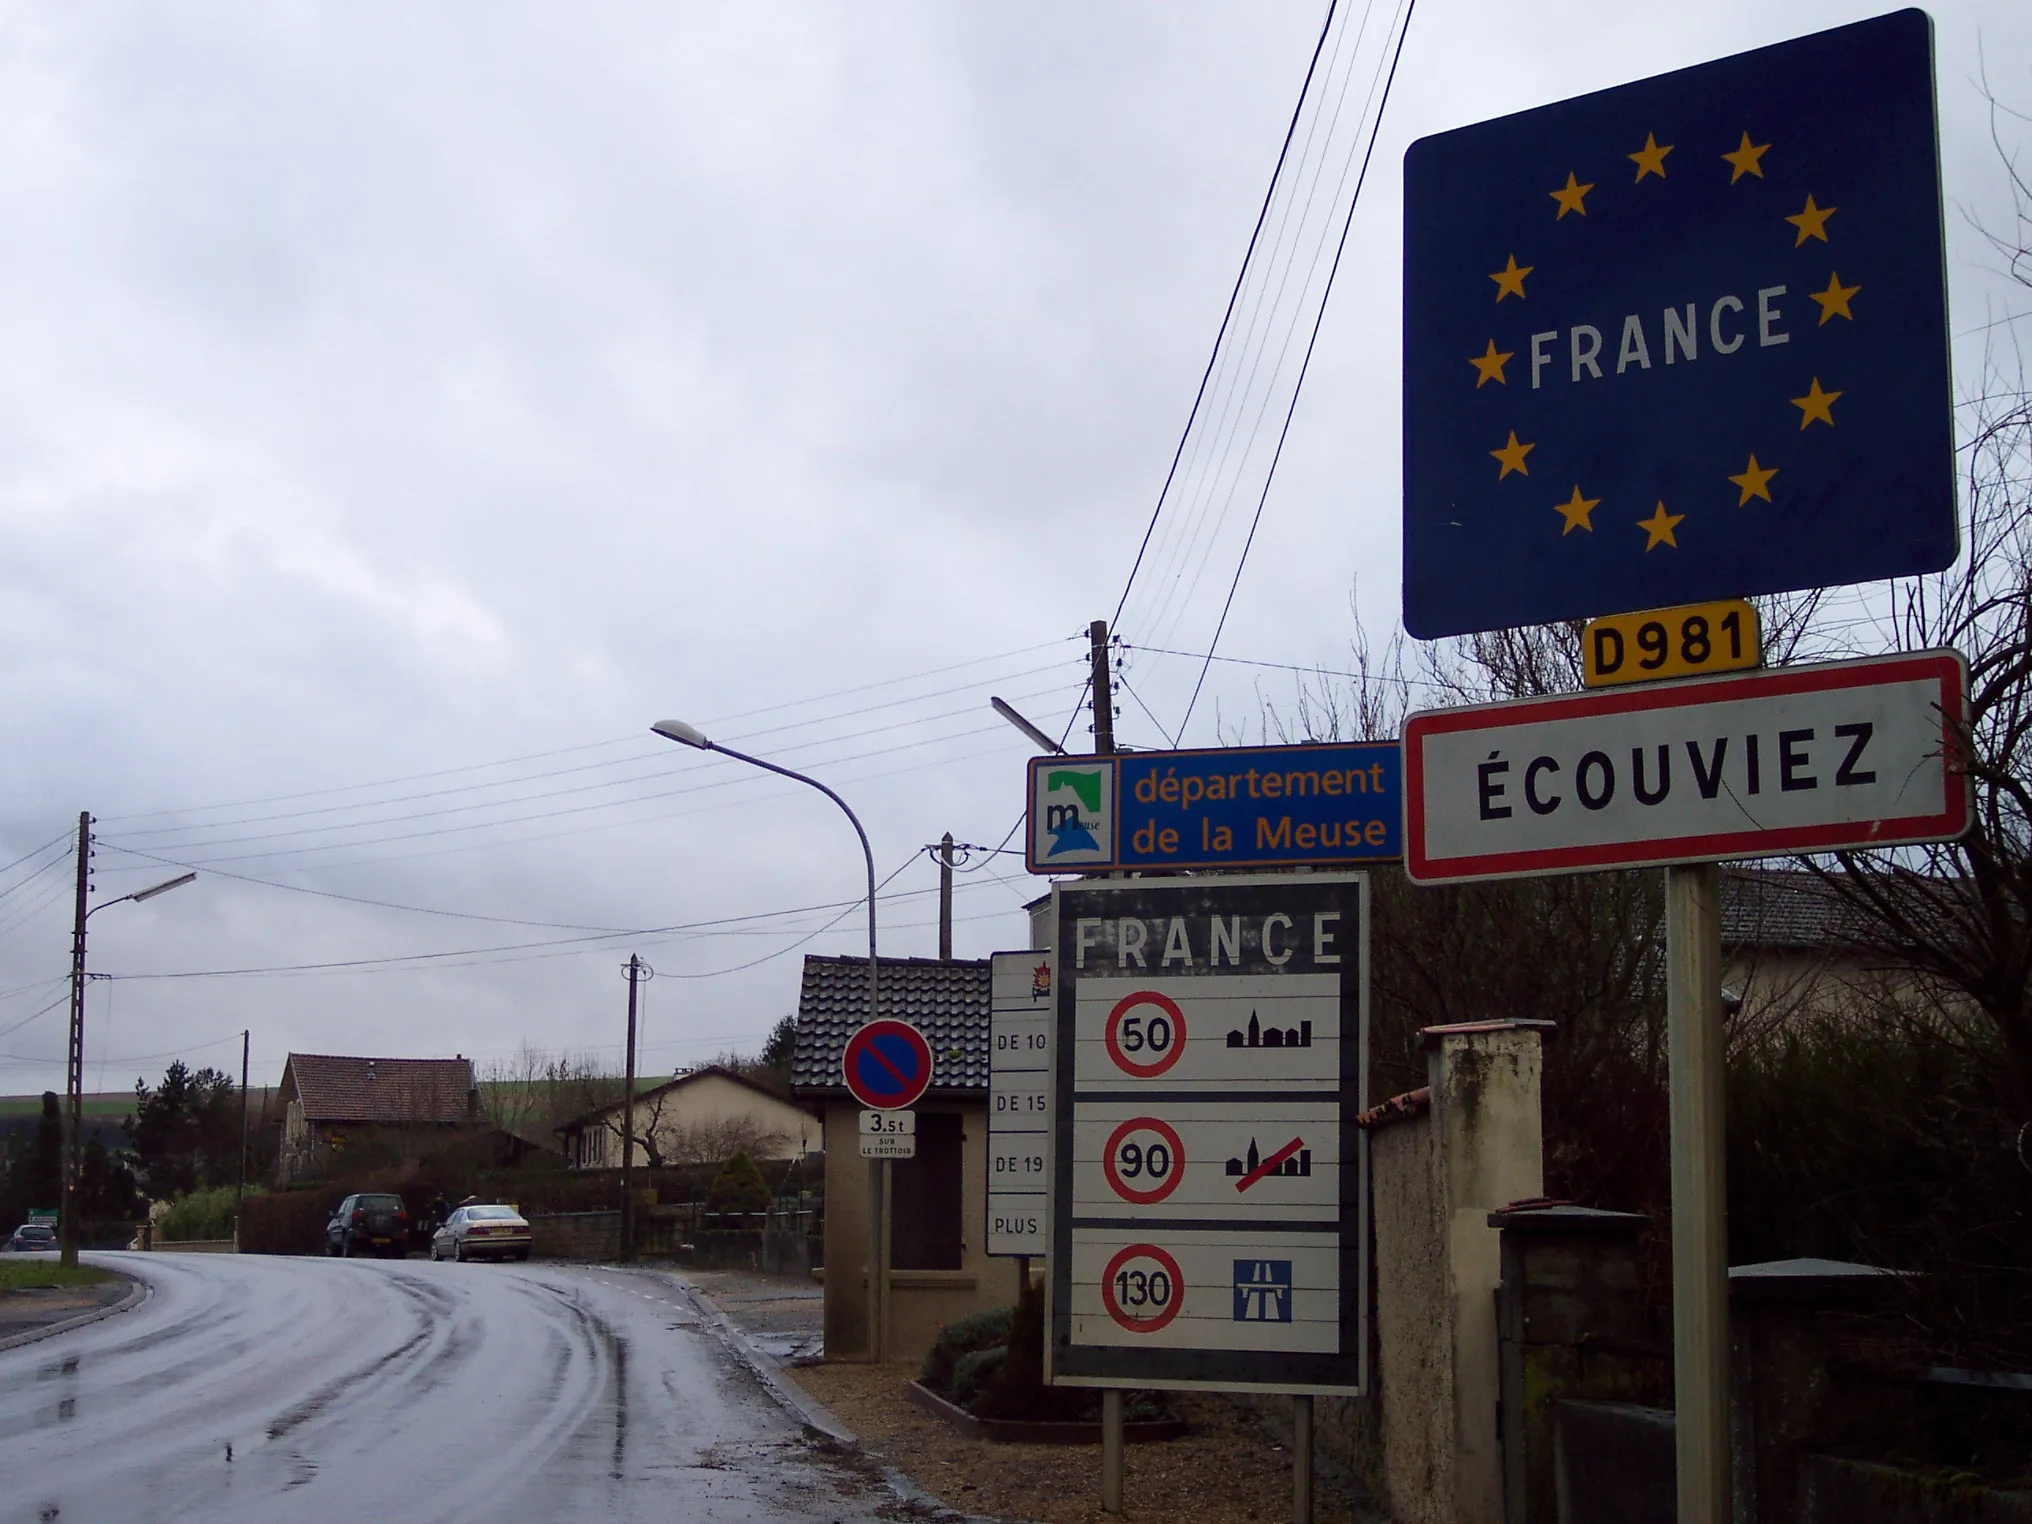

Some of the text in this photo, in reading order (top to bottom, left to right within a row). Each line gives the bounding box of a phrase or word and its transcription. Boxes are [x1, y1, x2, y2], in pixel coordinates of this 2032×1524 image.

[1530, 284, 1790, 389] FRANCE
[1134, 762, 1385, 810] département
[1477, 722, 1877, 821] ÉCOUVIEZ
[1132, 815, 1387, 854] de la Meuse
[1075, 911, 1342, 970] FRANCE
[998, 1034, 1046, 1050] DE 10
[1123, 1016, 1170, 1052] 50
[997, 1095, 1046, 1111] DE 15
[862, 1147, 872, 1155] LE
[996, 1157, 1043, 1172] DE 19
[1119, 1143, 1170, 1178] 90
[995, 1218, 1037, 1234] PLUS
[1115, 1270, 1170, 1306] 130
